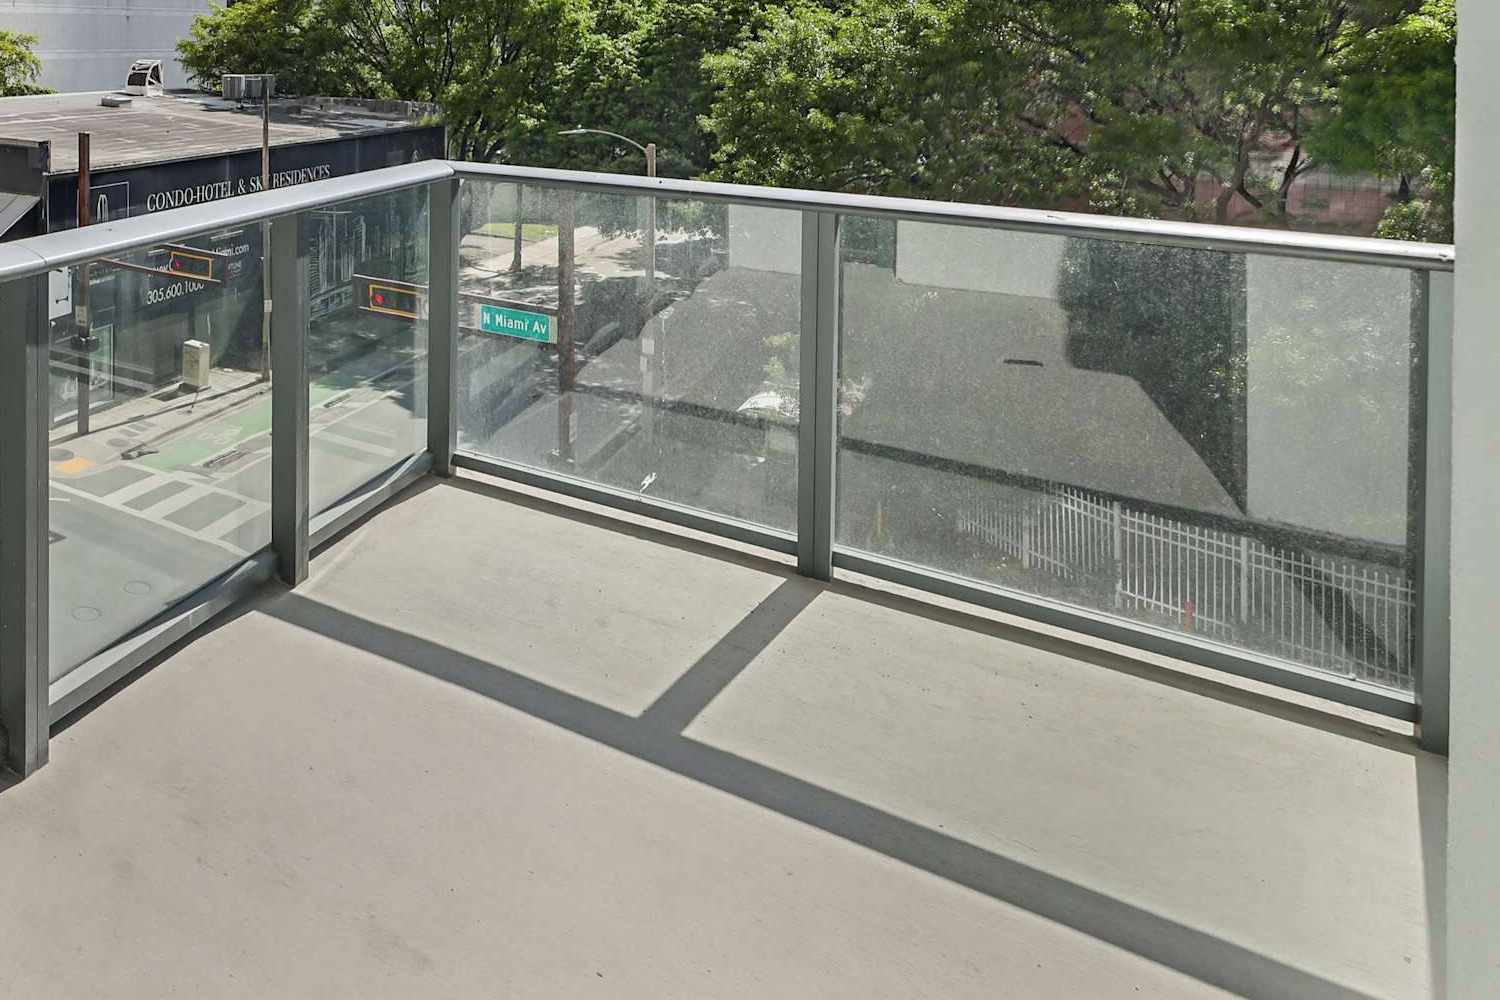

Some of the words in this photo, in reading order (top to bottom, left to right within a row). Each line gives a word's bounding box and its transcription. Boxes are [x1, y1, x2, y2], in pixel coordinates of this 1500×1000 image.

[146, 180, 235, 212] CONDO-HOTEL
[237, 178, 246, 195] &
[273, 164, 331, 189] RESIDENCES
[482, 311, 491, 325] N
[495, 313, 530, 332] Miami
[533, 320, 547, 334] Av
